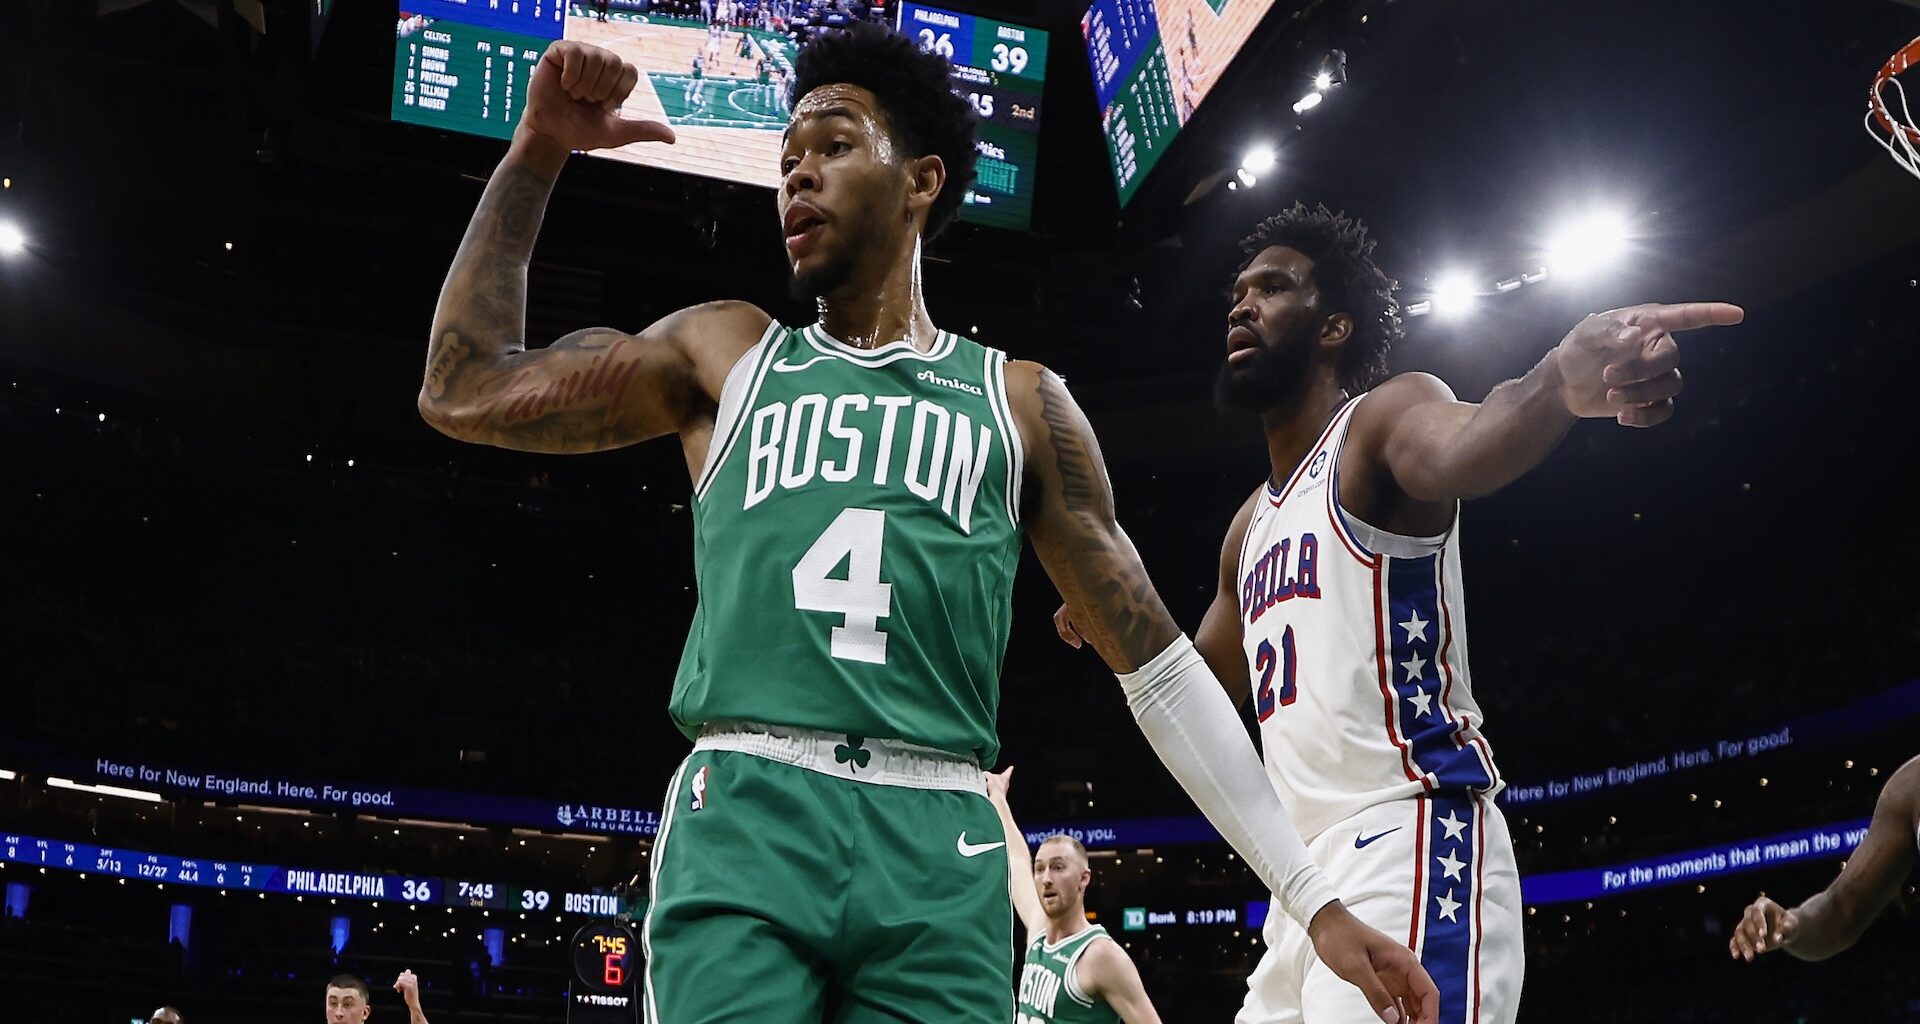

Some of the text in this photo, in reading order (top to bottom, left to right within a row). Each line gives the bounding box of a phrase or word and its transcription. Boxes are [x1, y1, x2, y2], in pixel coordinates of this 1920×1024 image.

[423, 30, 452, 44] CELTICS
[997, 25, 1025, 42] BOSTON
[422, 45, 449, 61] SIMONS
[477, 41, 491, 52] PTS
[523, 49, 538, 60] AST
[991, 43, 1028, 75] 39
[407, 68, 415, 80] 11
[420, 70, 458, 87] PRITCHARD
[505, 85, 512, 97] 2
[409, 56, 415, 67] 7
[421, 58, 446, 73] BROWN
[507, 73, 513, 85] 3
[404, 80, 415, 93] 26
[420, 83, 449, 99] TILLMAN
[418, 96, 446, 111] HAUSER
[1011, 103, 1035, 119] 2nd
[916, 370, 983, 396] Amica
[743, 393, 992, 537] BOSTON
[792, 507, 892, 665] 4
[1242, 532, 1322, 625] PHILA
[1255, 623, 1298, 724] 21
[96, 757, 394, 806] Here for New England. Here. For good.
[1506, 785, 1544, 802] Here
[1548, 780, 1570, 797] for
[1573, 774, 1604, 793] New
[1718, 740, 1744, 758] For
[574, 804, 660, 826] ARBELL
[5, 836, 19, 845] AST
[64, 843, 75, 853] TO
[99, 848, 113, 858] 3PT
[1087, 828, 1116, 844] you.
[8, 846, 251, 887] 8 1 6 5/13 12/27 44.4 6 2
[1602, 870, 1627, 890] For
[1629, 865, 1653, 885] the
[1656, 852, 1726, 880] moments
[1728, 844, 1761, 867] that
[1763, 838, 1809, 861] mean
[1812, 831, 1841, 852] the
[286, 870, 431, 901] PHILADELPHIA 36
[458, 881, 494, 899] 7:45
[521, 889, 618, 916] 39 BOSTON
[1125, 911, 1176, 927] TD Bank
[1186, 909, 1236, 924] 8:19 PM
[594, 935, 626, 955] 7:45
[605, 953, 622, 985] 6
[590, 995, 628, 1007] TISSOT
